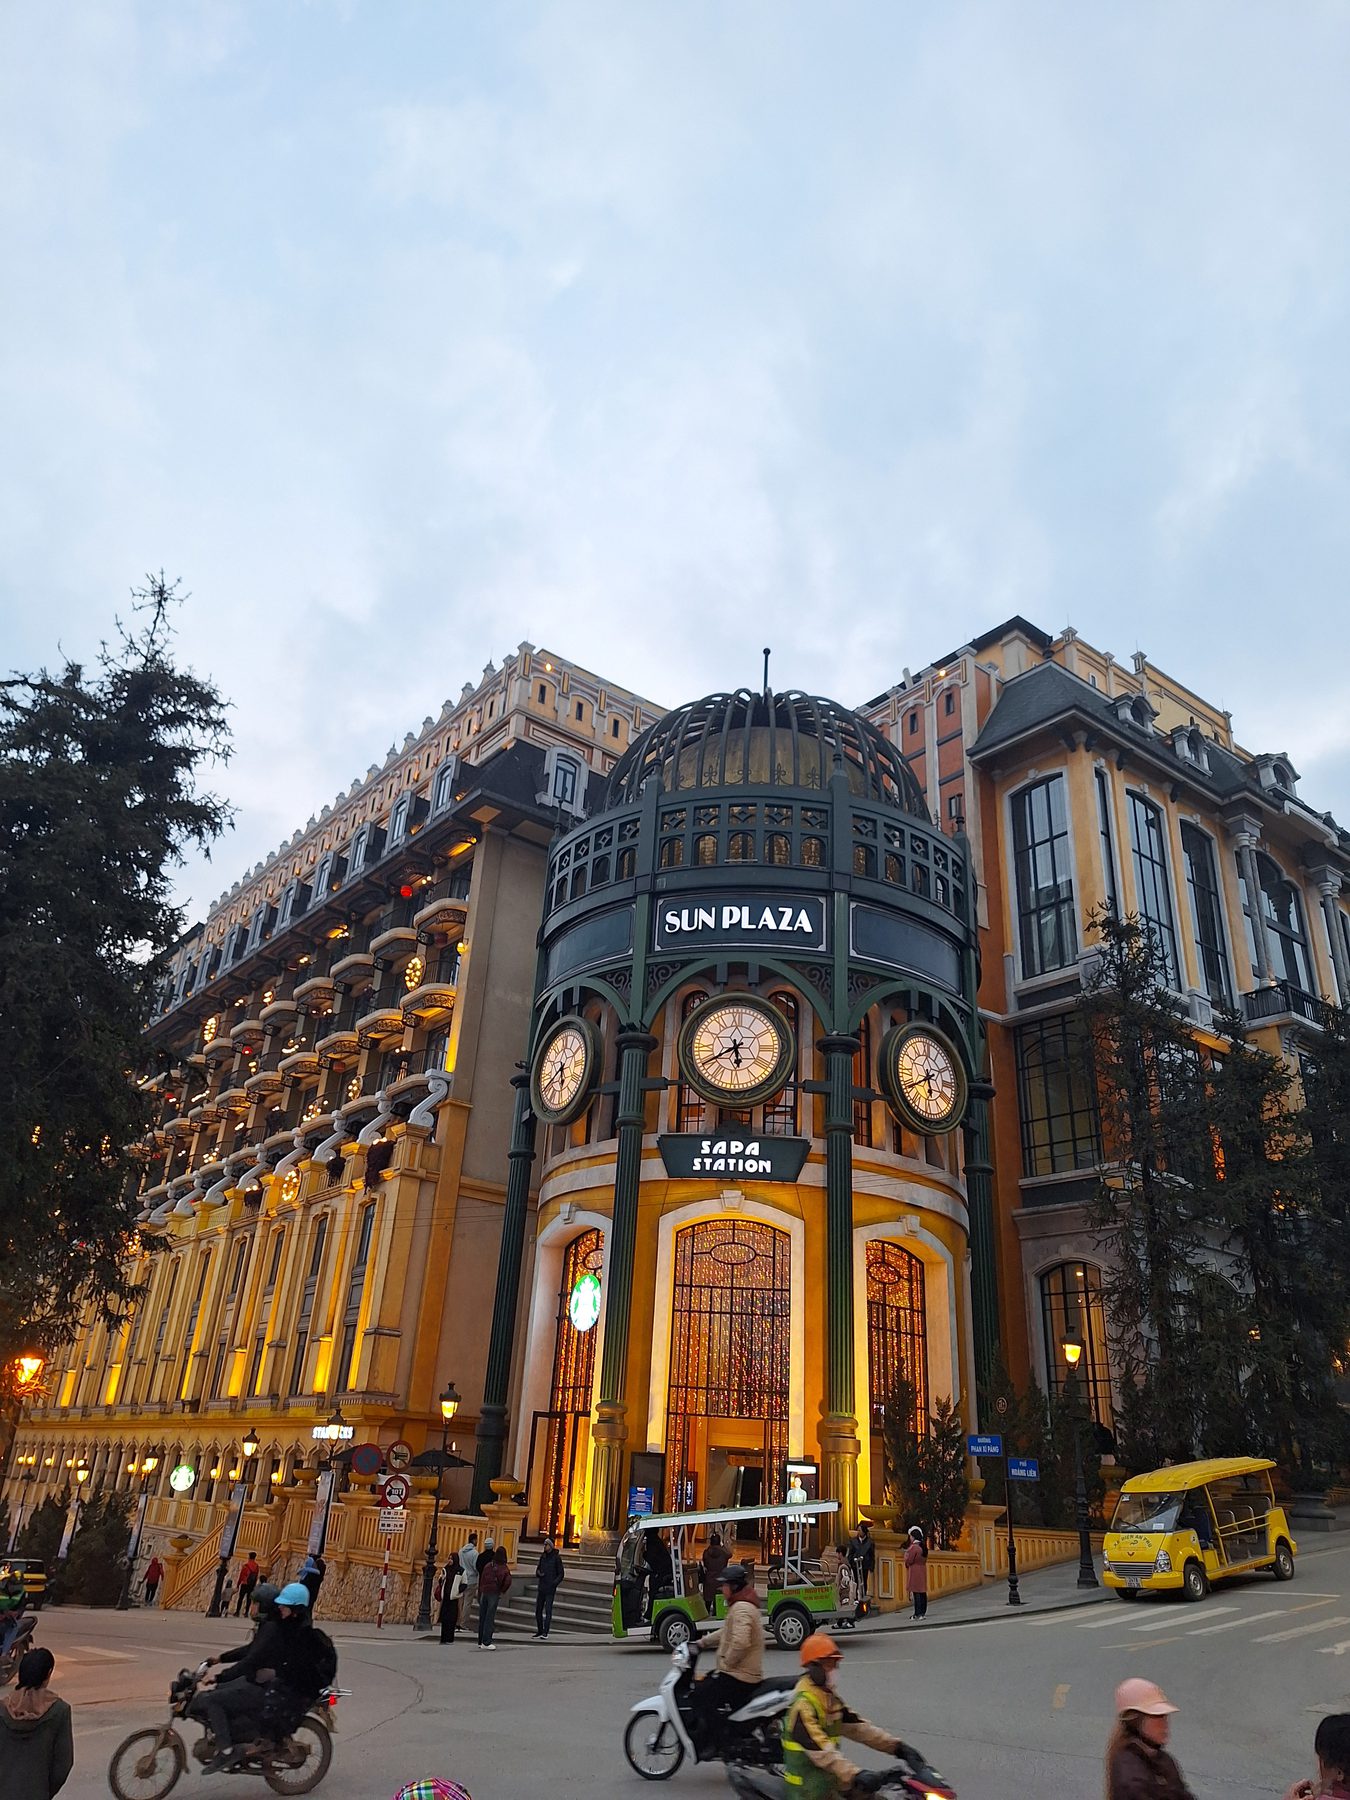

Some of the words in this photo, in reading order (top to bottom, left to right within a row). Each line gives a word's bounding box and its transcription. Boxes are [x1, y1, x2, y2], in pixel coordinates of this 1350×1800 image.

[664, 906, 716, 933] SUN
[721, 905, 813, 933] PLAZA
[701, 1141, 760, 1155] SAPA
[693, 1158, 772, 1173] STATION
[312, 1426, 354, 1440] STARCKS
